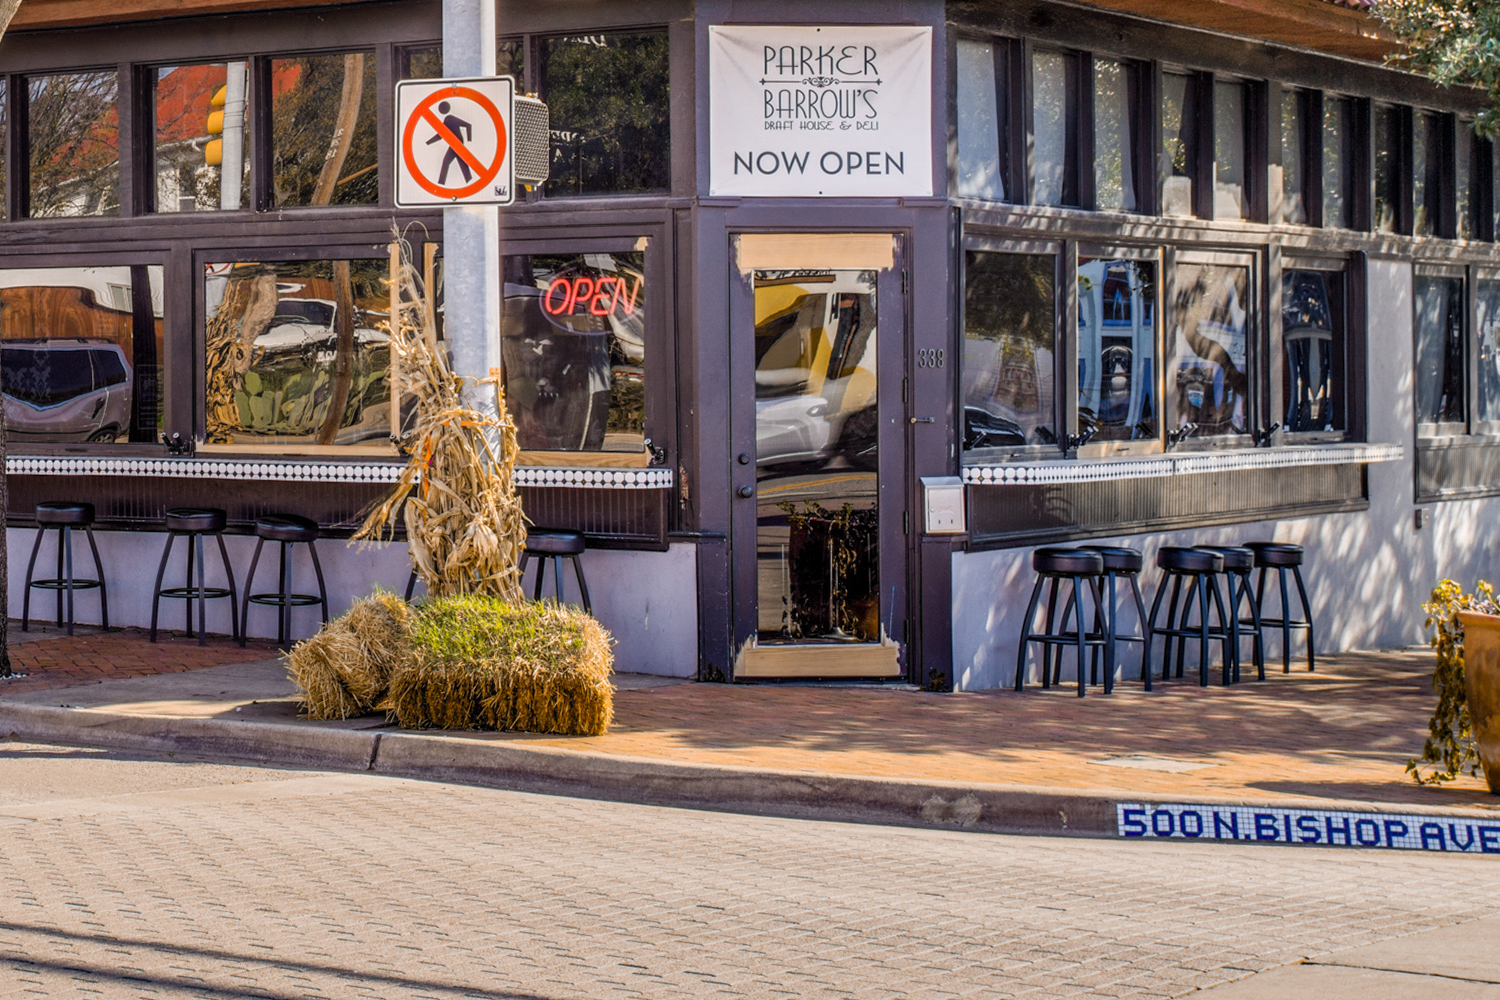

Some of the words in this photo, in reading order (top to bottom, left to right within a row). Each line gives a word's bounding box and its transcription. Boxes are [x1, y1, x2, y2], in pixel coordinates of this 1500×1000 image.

[764, 45, 879, 75] PARKER
[764, 89, 879, 119] BARROW'S
[764, 121, 794, 130] DRAFT
[799, 121, 834, 130] HOUSE
[839, 121, 852, 130] &
[856, 121, 879, 130] DELI
[734, 151, 810, 175] NOW
[820, 151, 904, 175] OPEN
[545, 277, 641, 315] OPEN
[918, 348, 945, 369] 338
[1123, 809, 1203, 837] 500
[1420, 822, 1500, 854] AVE
